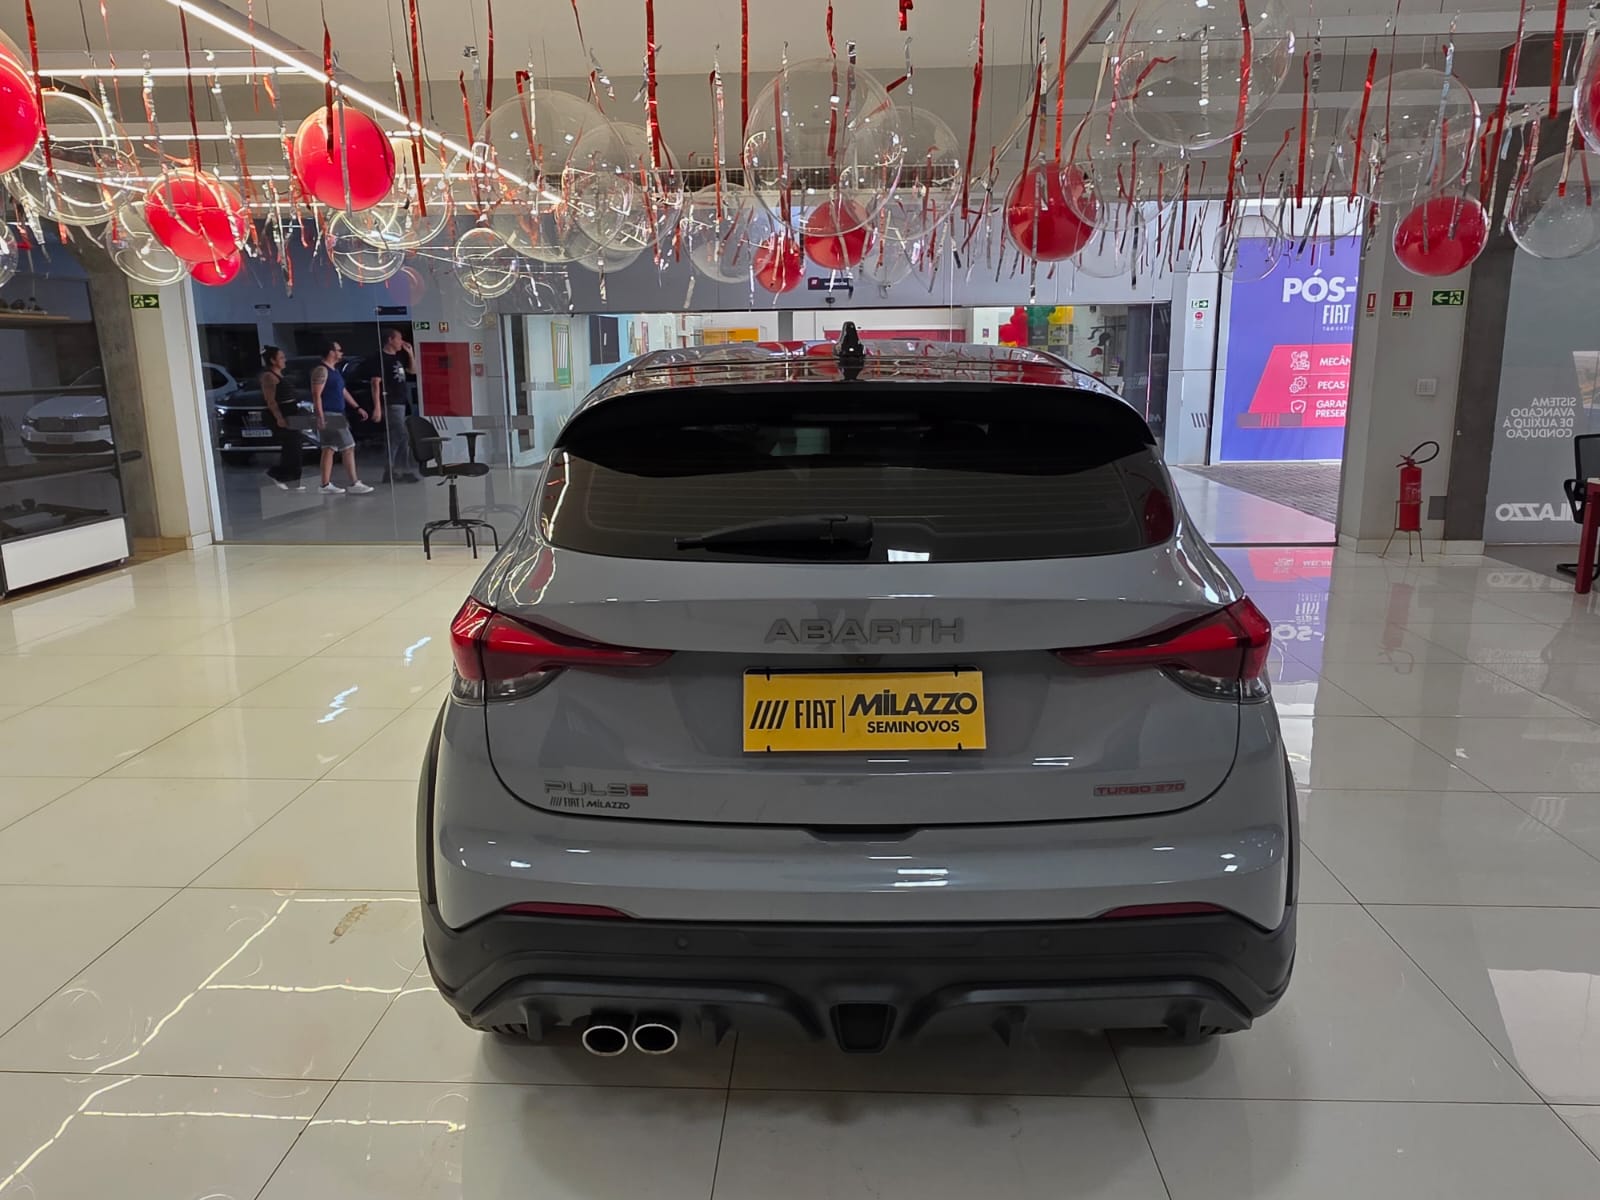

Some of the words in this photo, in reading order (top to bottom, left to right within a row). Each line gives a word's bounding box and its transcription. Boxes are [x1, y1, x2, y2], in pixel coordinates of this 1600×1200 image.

[1282, 268, 1358, 303] PÓS-
[1322, 304, 1351, 325] FIAT
[764, 618, 964, 644] ABARTH
[795, 699, 837, 729] FIAT
[867, 719, 960, 733] SEMINOVOS
[1095, 785, 1153, 796] TURBO
[1155, 782, 1185, 793] 270
